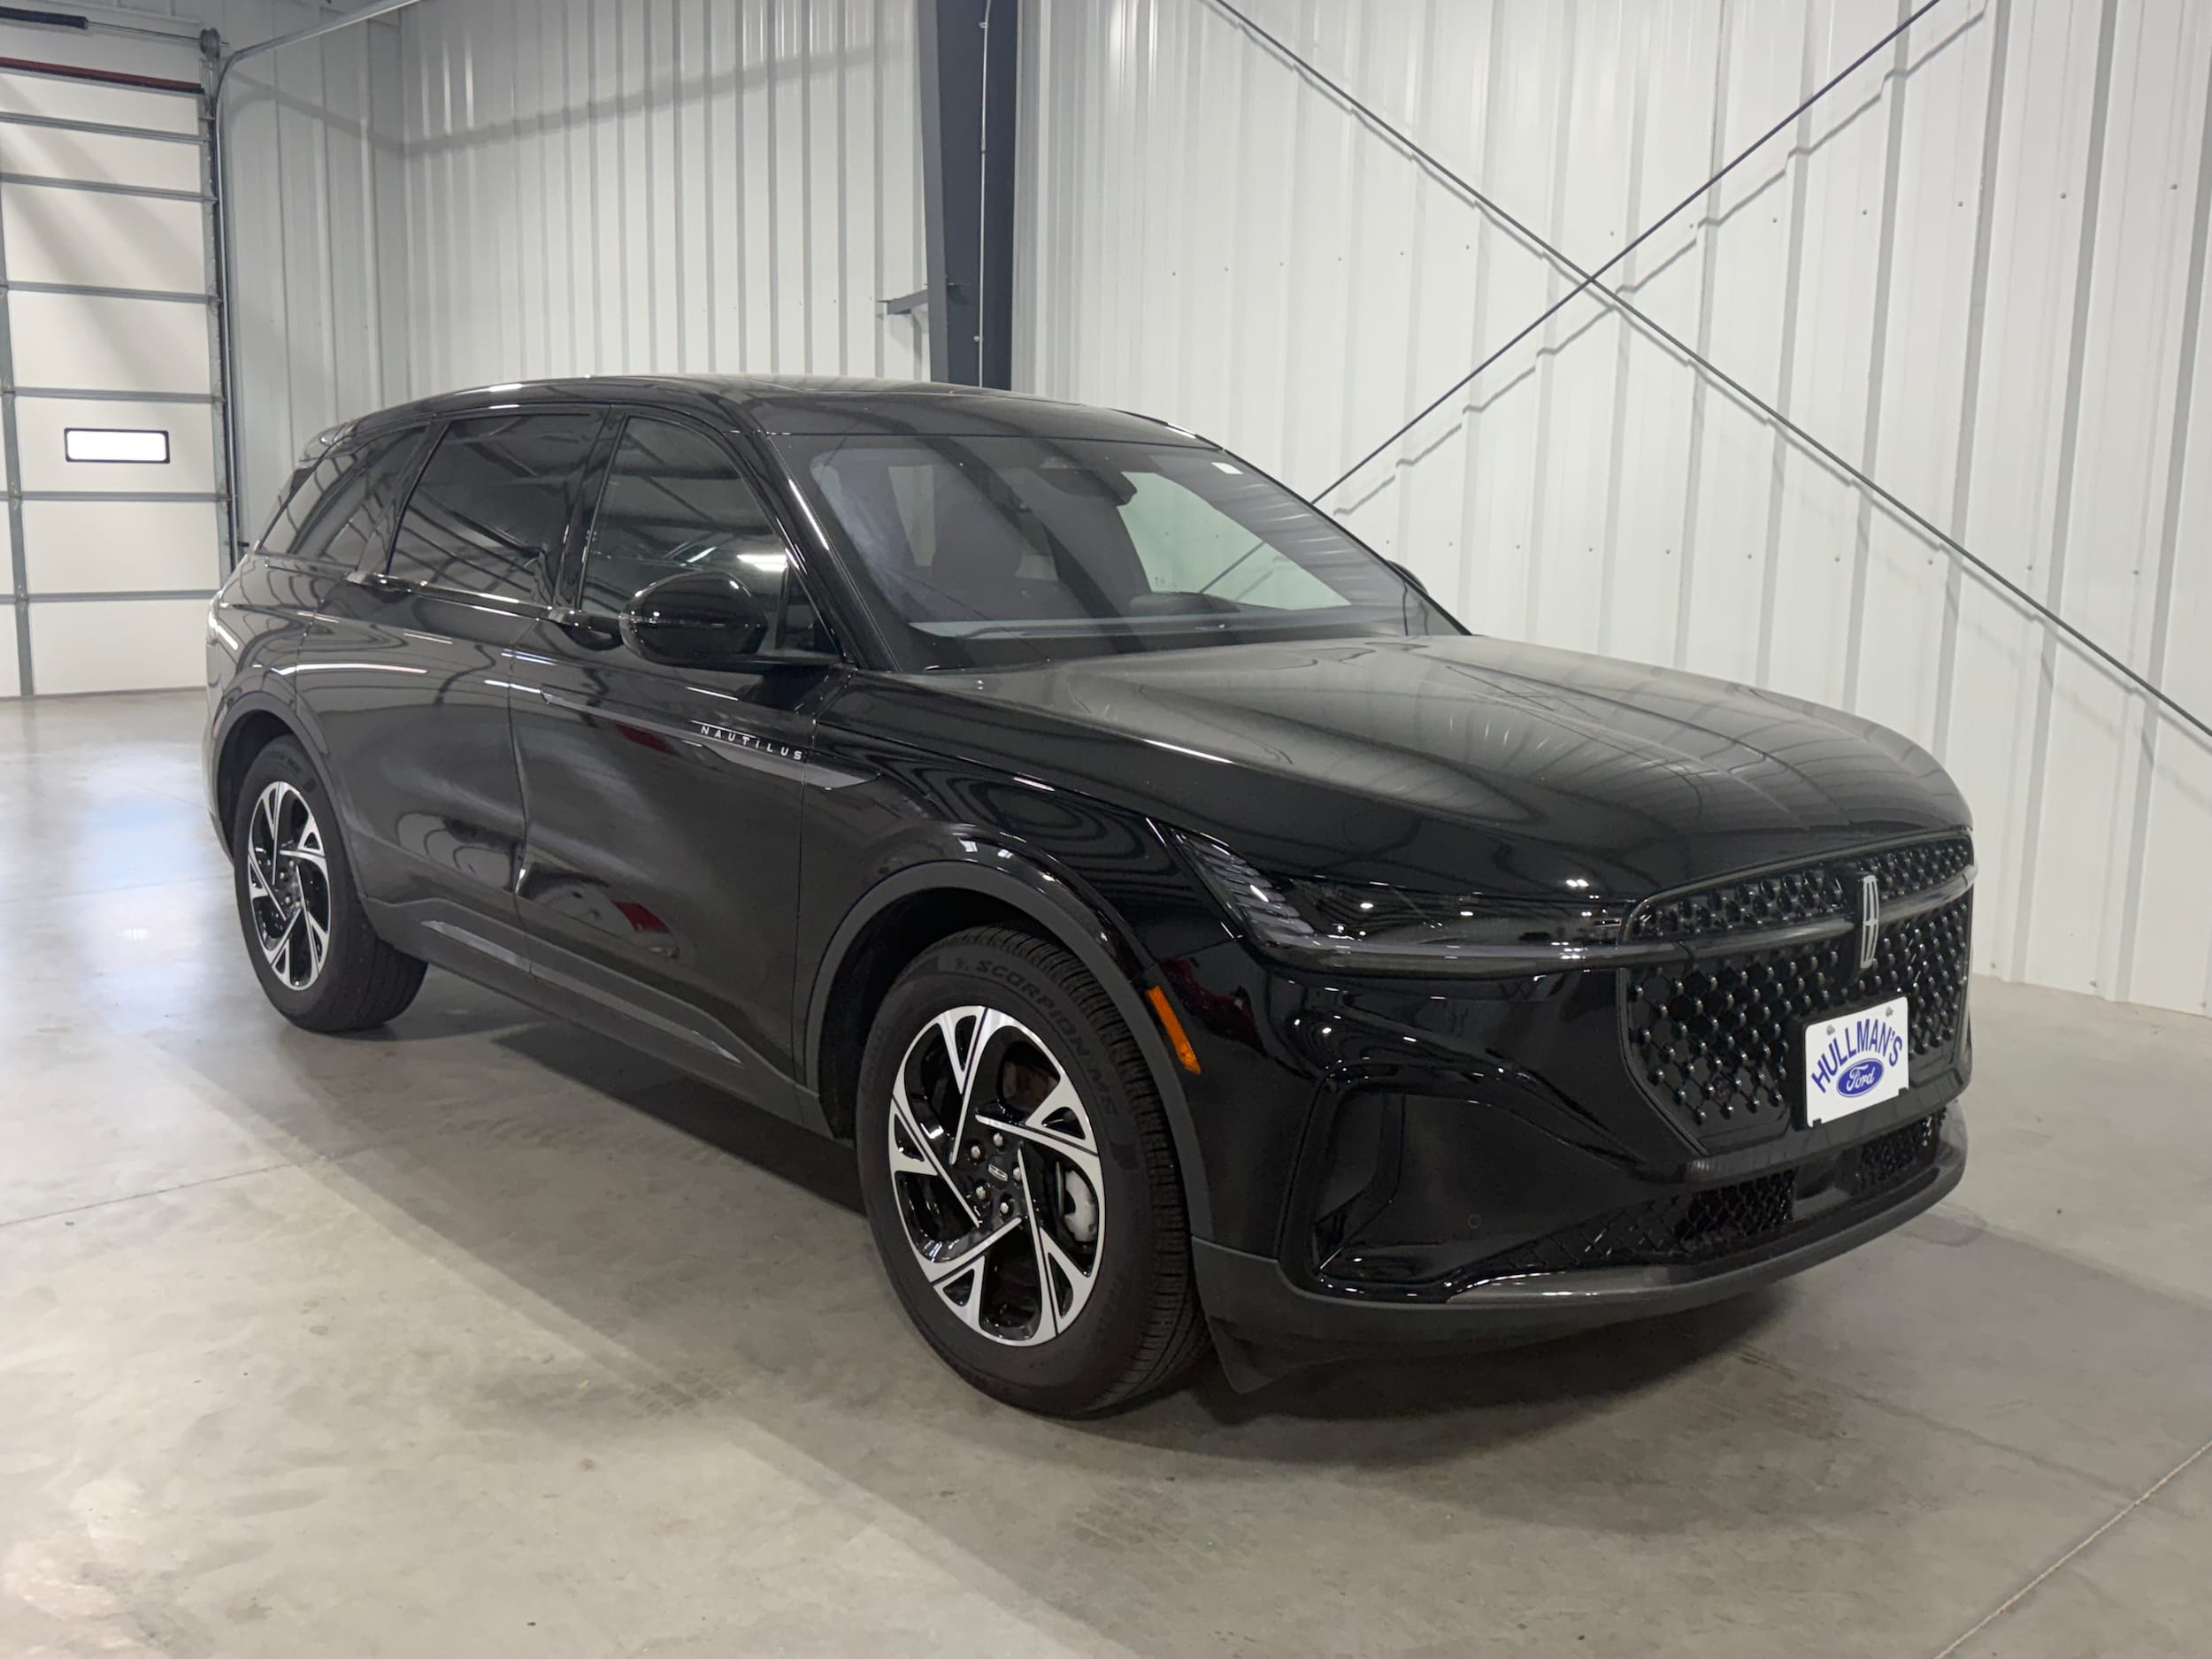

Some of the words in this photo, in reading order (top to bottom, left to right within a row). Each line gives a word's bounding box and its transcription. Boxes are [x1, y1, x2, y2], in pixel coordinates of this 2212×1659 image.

[701, 726, 803, 760] NAUTILUS
[976, 959, 1089, 1056] SCORPION
[1811, 1018, 1902, 1094] HULLMAN'S
[1846, 1064, 1876, 1092] Ford
